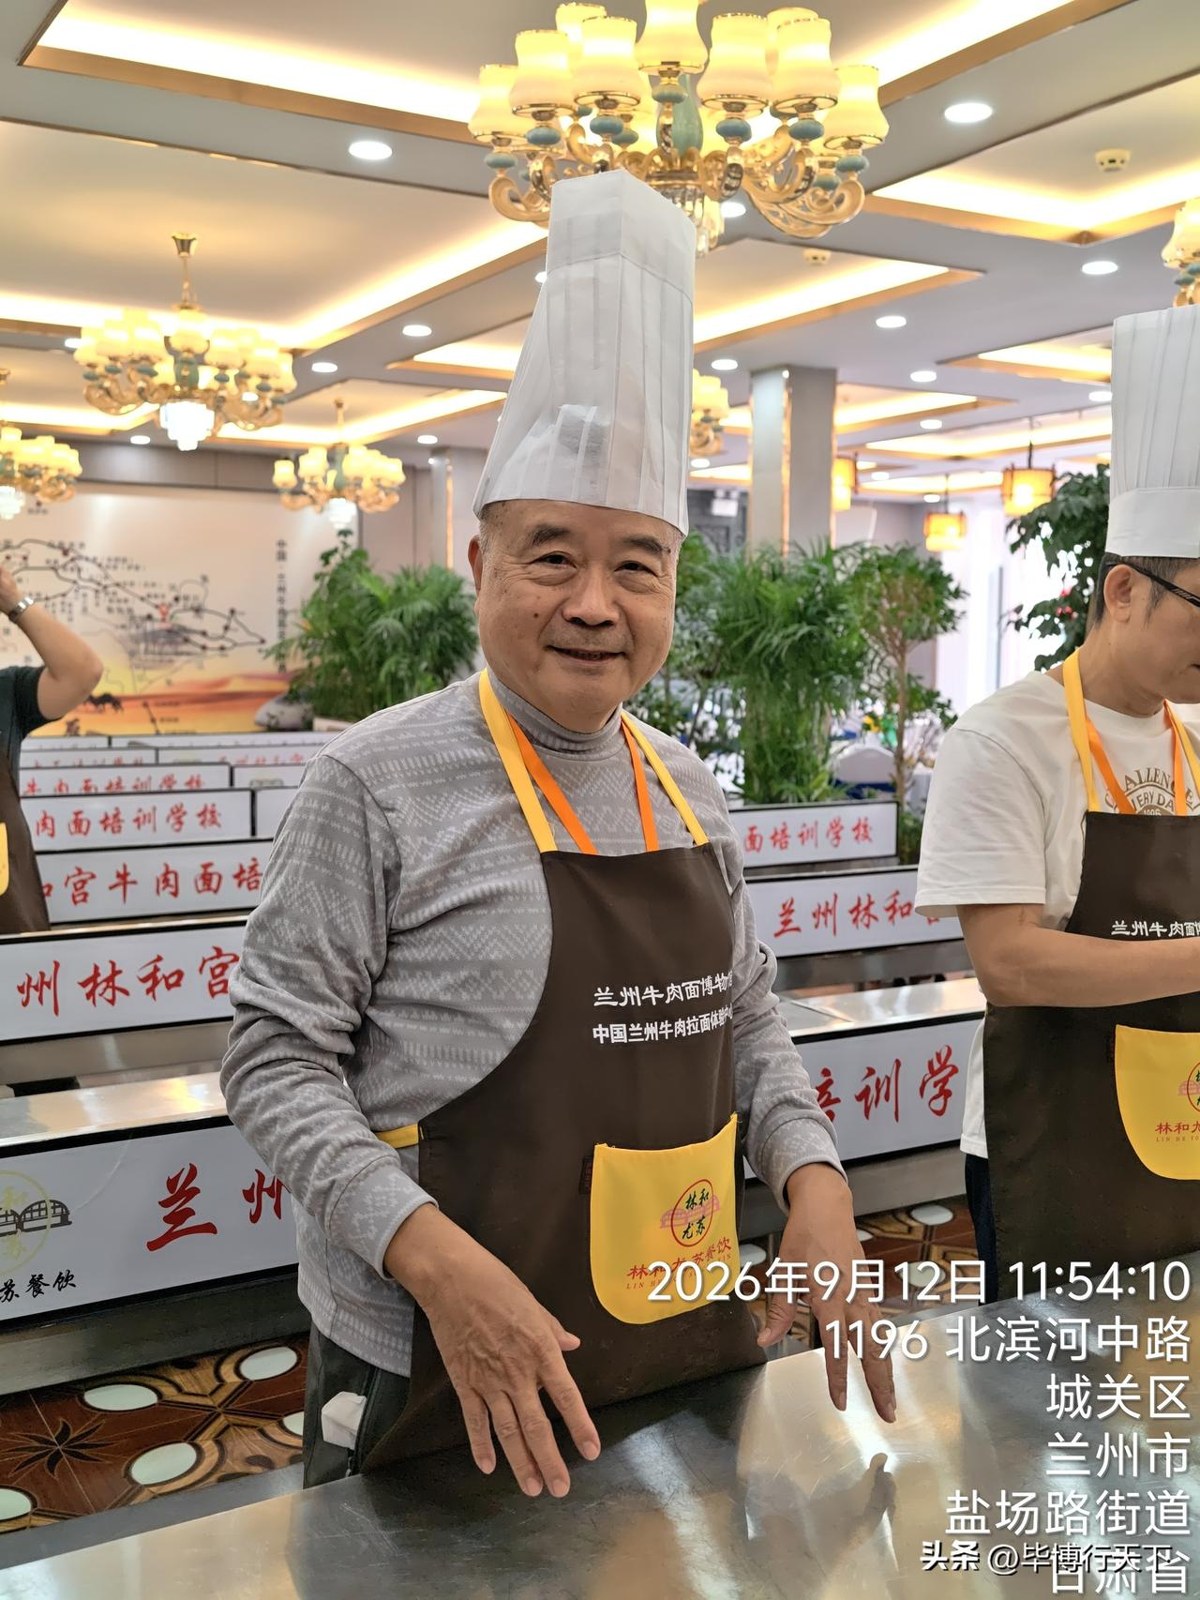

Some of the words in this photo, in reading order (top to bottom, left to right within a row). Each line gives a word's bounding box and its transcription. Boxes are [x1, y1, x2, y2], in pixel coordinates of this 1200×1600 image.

[35, 802, 222, 838] 肉面培训学校
[743, 816, 873, 853] 面培训学校
[773, 890, 941, 938] 兰州林和
[16, 946, 239, 1017] 州林和宫
[0, 1269, 76, 1302] 苏餐饮
